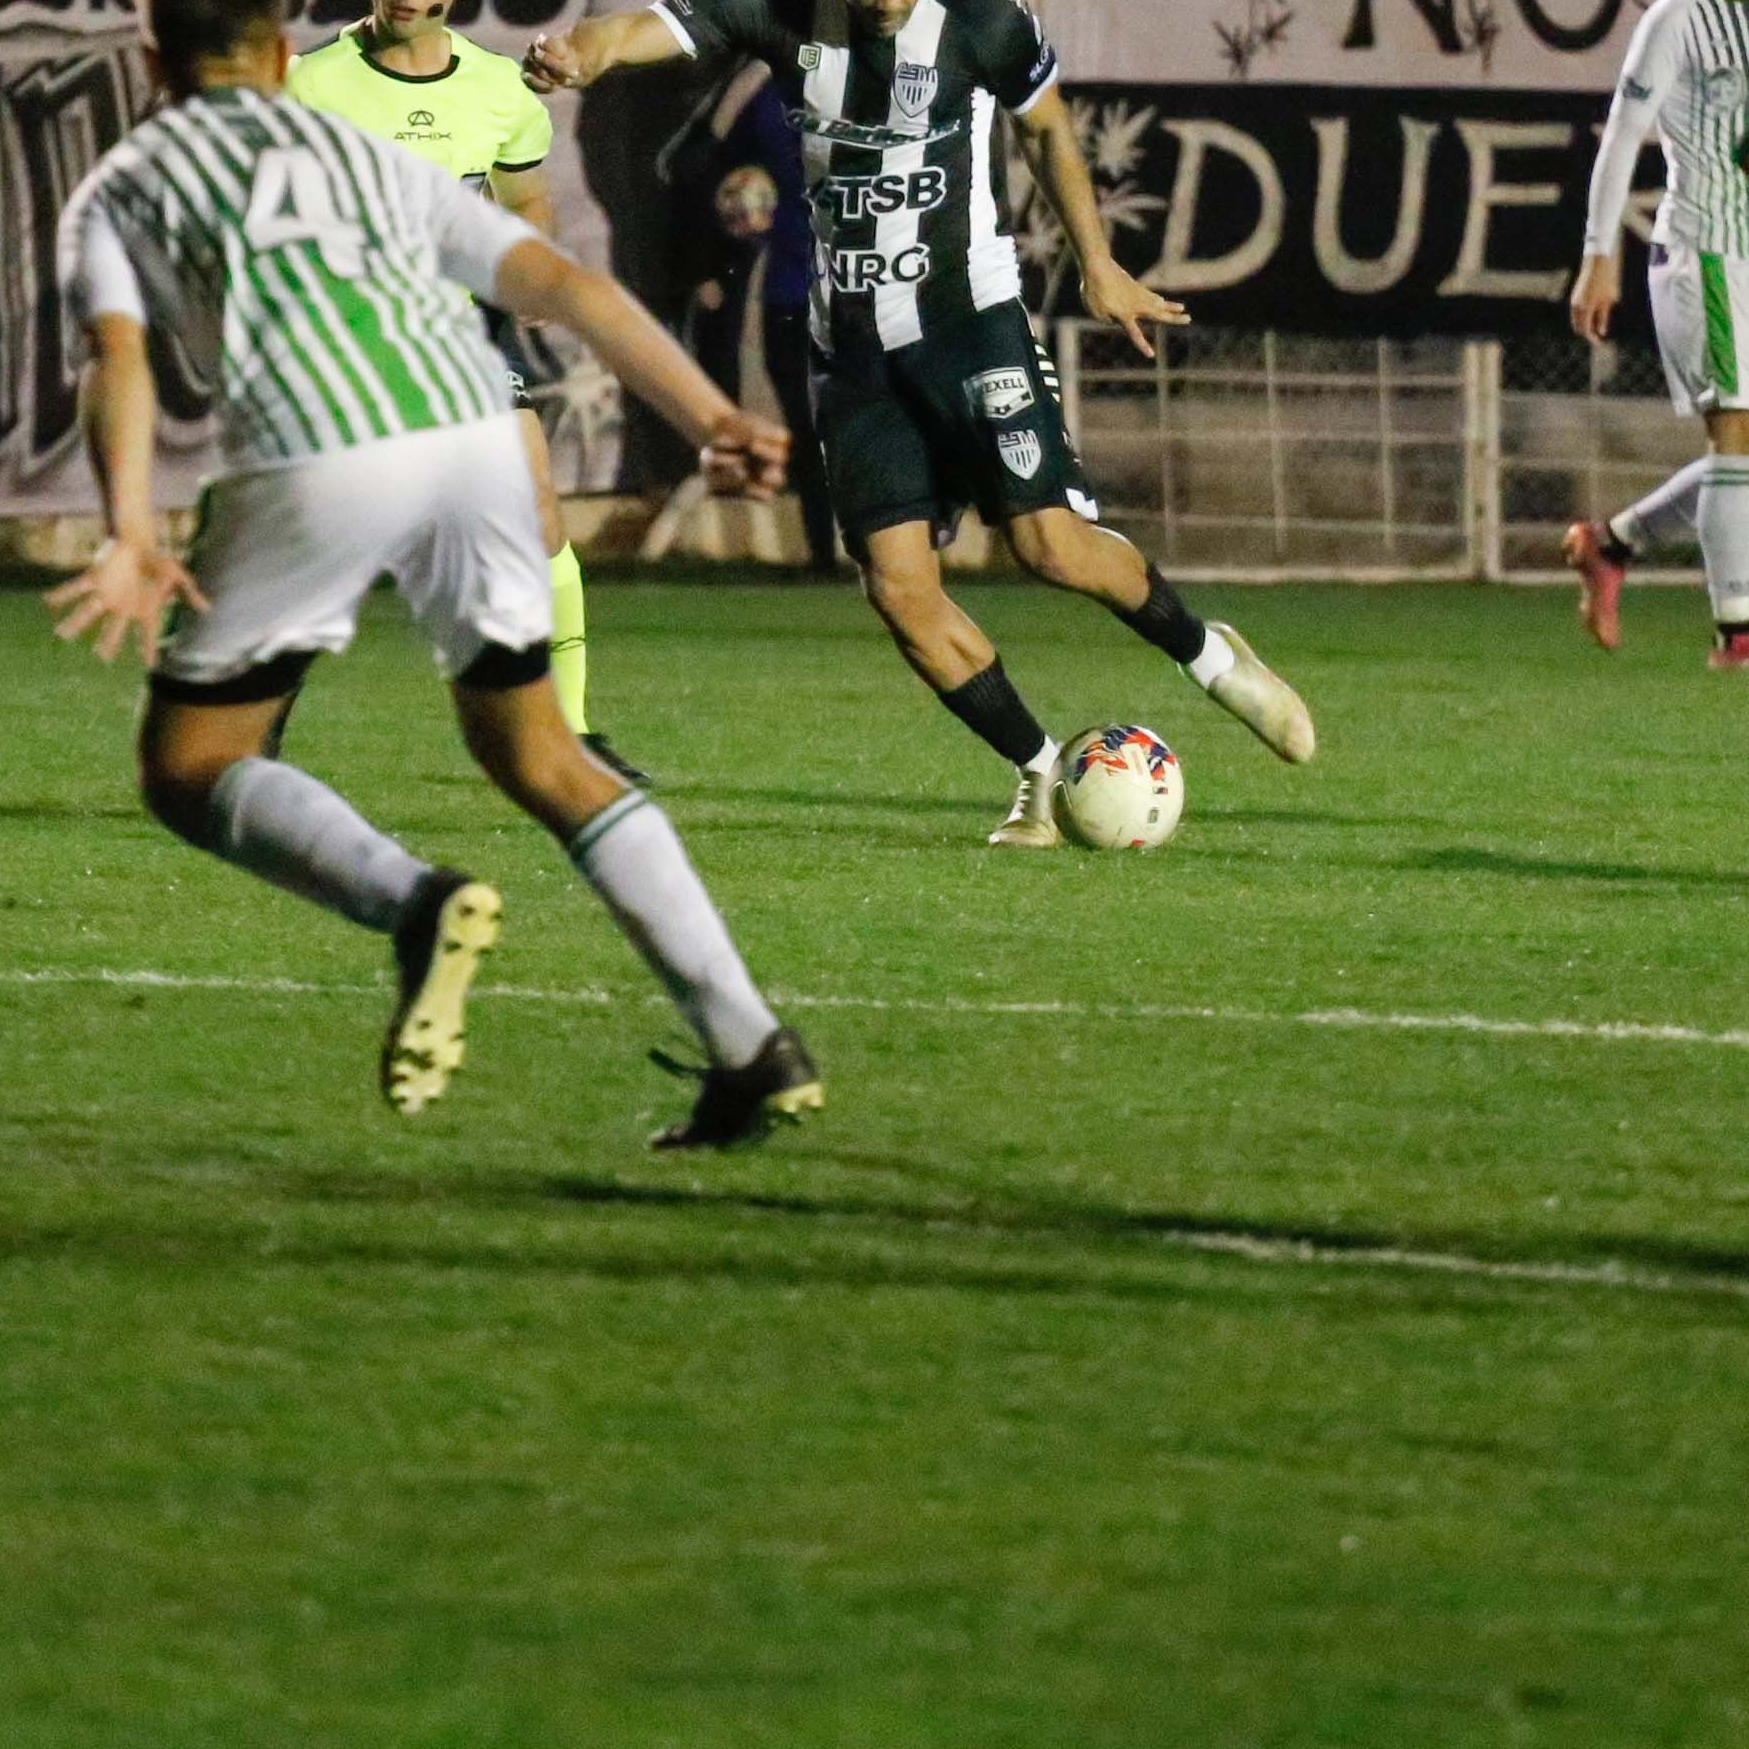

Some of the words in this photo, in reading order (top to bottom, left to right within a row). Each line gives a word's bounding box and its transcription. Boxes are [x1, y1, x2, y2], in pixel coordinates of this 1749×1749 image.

[393, 131, 452, 141] ATHIX
[246, 148, 371, 277] 4
[831, 166, 948, 219] TSB
[824, 241, 932, 293] NRG
